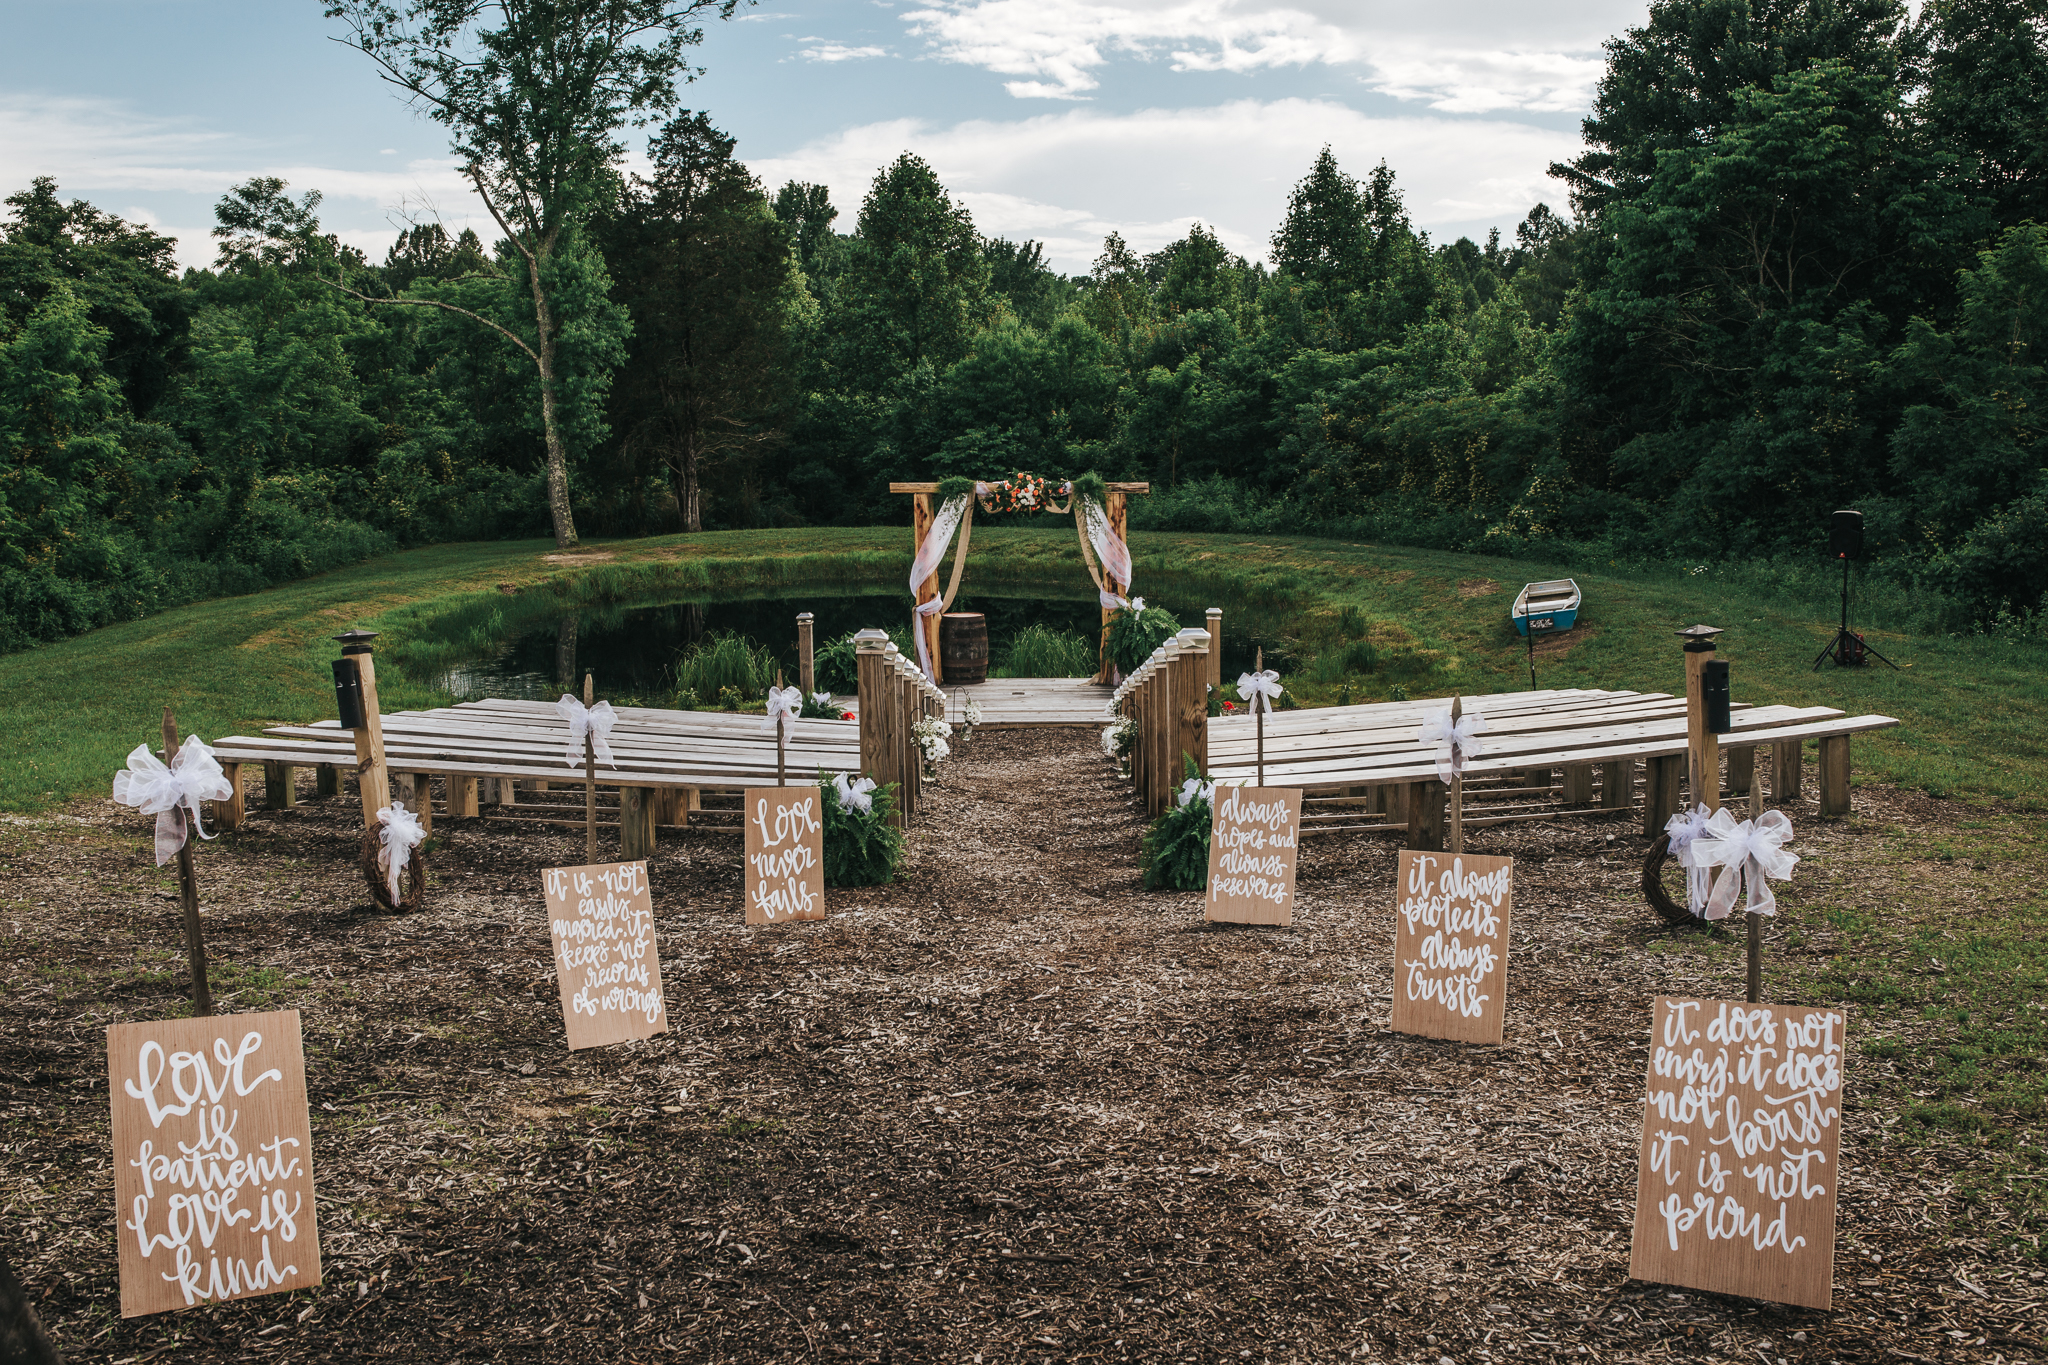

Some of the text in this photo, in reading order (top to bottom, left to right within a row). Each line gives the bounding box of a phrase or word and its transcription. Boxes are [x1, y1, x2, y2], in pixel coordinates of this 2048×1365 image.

[752, 797, 821, 848] Love
[1220, 787, 1291, 831] always
[750, 844, 817, 879] never
[1213, 819, 1297, 855] hopes and
[547, 862, 644, 901] it is not
[1219, 848, 1288, 877] always
[1408, 855, 1511, 907] it always
[578, 892, 631, 921] easily
[751, 877, 818, 919] fails
[627, 910, 651, 939] it
[557, 938, 650, 970] keeps no
[584, 959, 650, 988] records
[1420, 930, 1498, 984] always
[572, 986, 662, 1024] of wrongs
[1404, 959, 1490, 1018] trusts
[1664, 1000, 1842, 1054] it does not
[124, 1031, 282, 1128] Love
[1737, 1043, 1777, 1091] it
[1775, 1049, 1840, 1091] does
[177, 1099, 238, 1161] is
[1649, 1084, 1838, 1158] not boast
[1650, 1129, 1826, 1200] it is not
[126, 1186, 301, 1258] Love is
[1659, 1192, 1806, 1254] proud
[161, 1235, 298, 1306] kind
